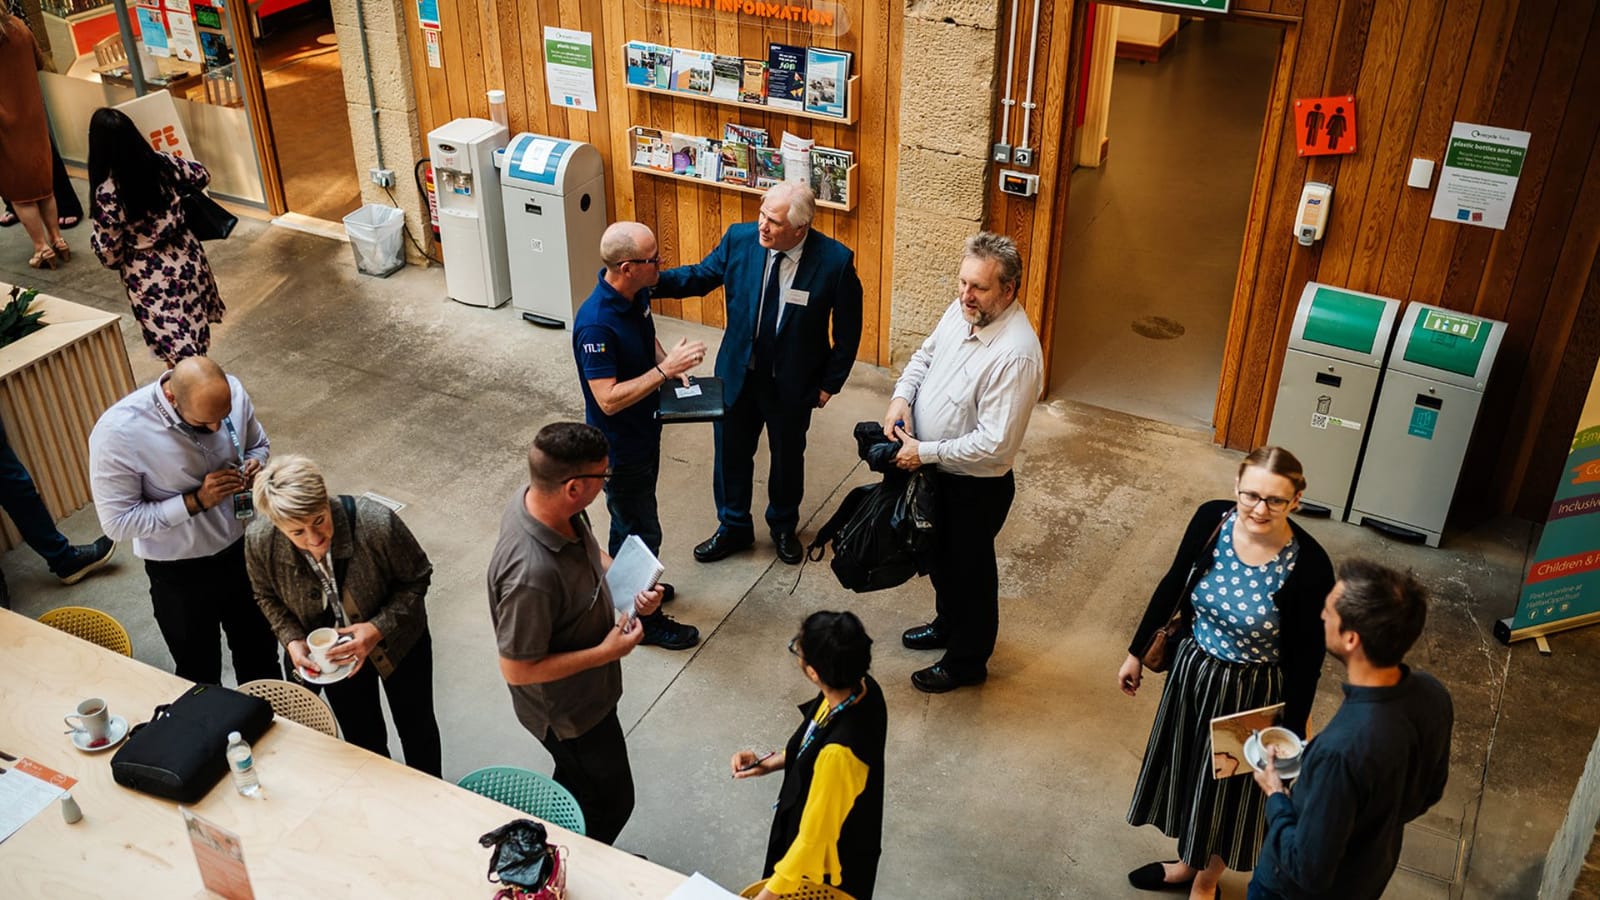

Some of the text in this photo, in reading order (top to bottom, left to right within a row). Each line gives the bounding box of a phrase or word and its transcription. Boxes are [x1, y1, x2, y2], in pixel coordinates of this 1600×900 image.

[714, 0, 834, 26] INFORMATION
[1453, 141, 1473, 150] plastic
[1475, 143, 1496, 152] bottles
[1537, 560, 1583, 575] Children
[1585, 555, 1593, 566] &
